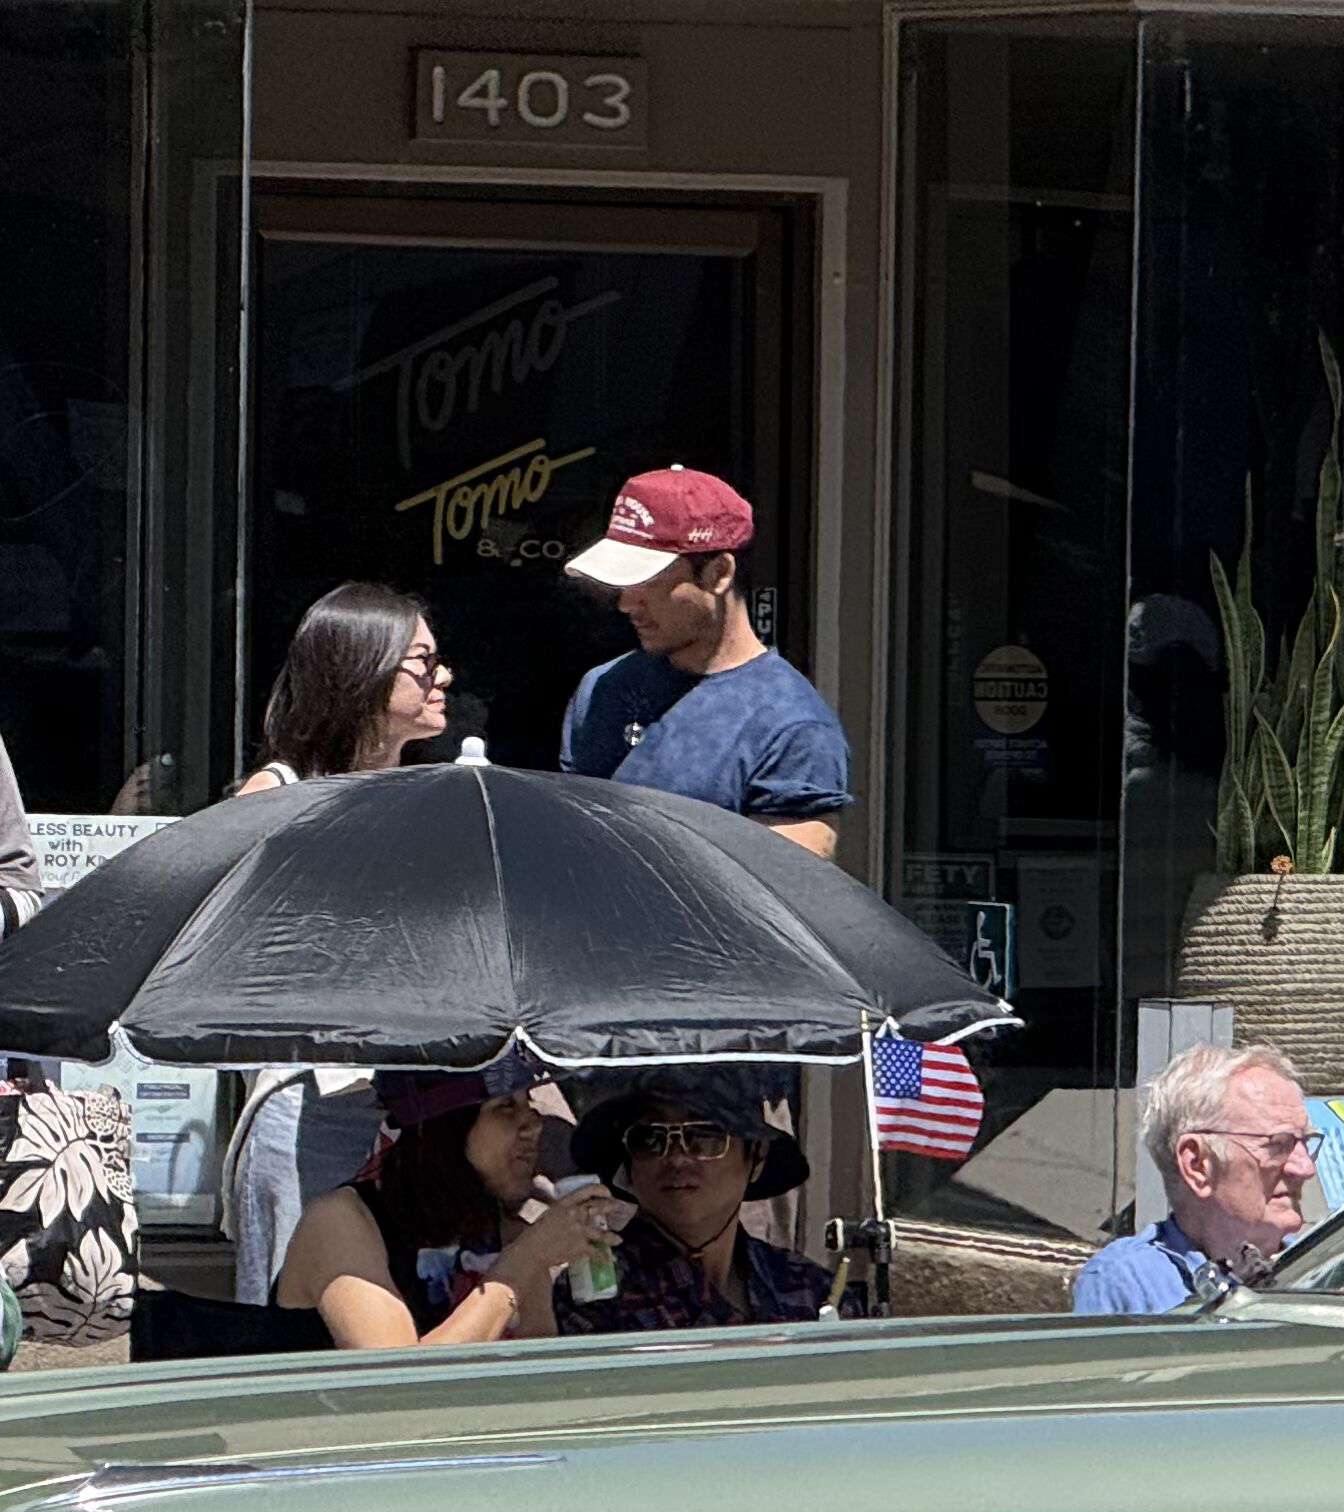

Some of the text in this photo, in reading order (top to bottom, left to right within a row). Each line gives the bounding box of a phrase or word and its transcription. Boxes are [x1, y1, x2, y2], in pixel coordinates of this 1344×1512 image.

[432, 65, 631, 128] 1403
[336, 276, 622, 469] Tomo
[395, 437, 596, 565] Tomo
[47, 840, 84, 852] with
[72, 824, 139, 838] BEAUTY
[44, 854, 80, 867] ROY
